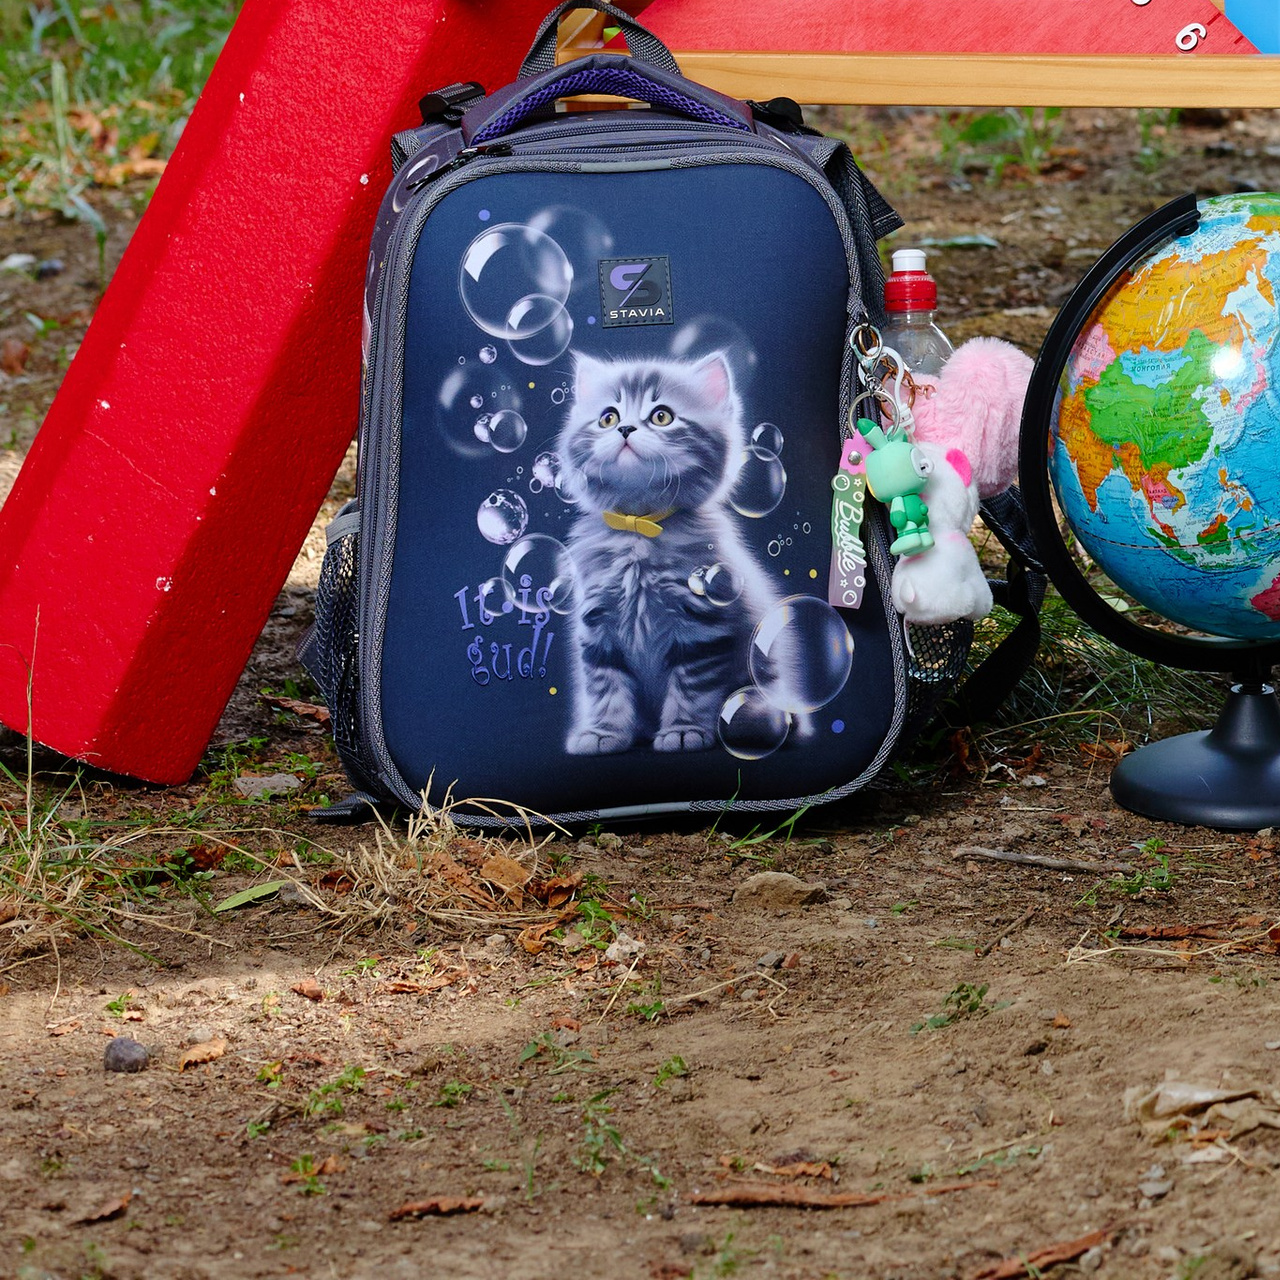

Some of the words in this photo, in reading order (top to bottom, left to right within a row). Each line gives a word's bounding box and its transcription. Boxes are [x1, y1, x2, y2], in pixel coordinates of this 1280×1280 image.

[1174, 22, 1208, 52] 6
[609, 307, 665, 319] STAVIA
[1131, 362, 1172, 374] МОНГОЛИЯ
[838, 498, 868, 573] Bubble
[453, 582, 495, 630] It
[518, 573, 554, 627] is
